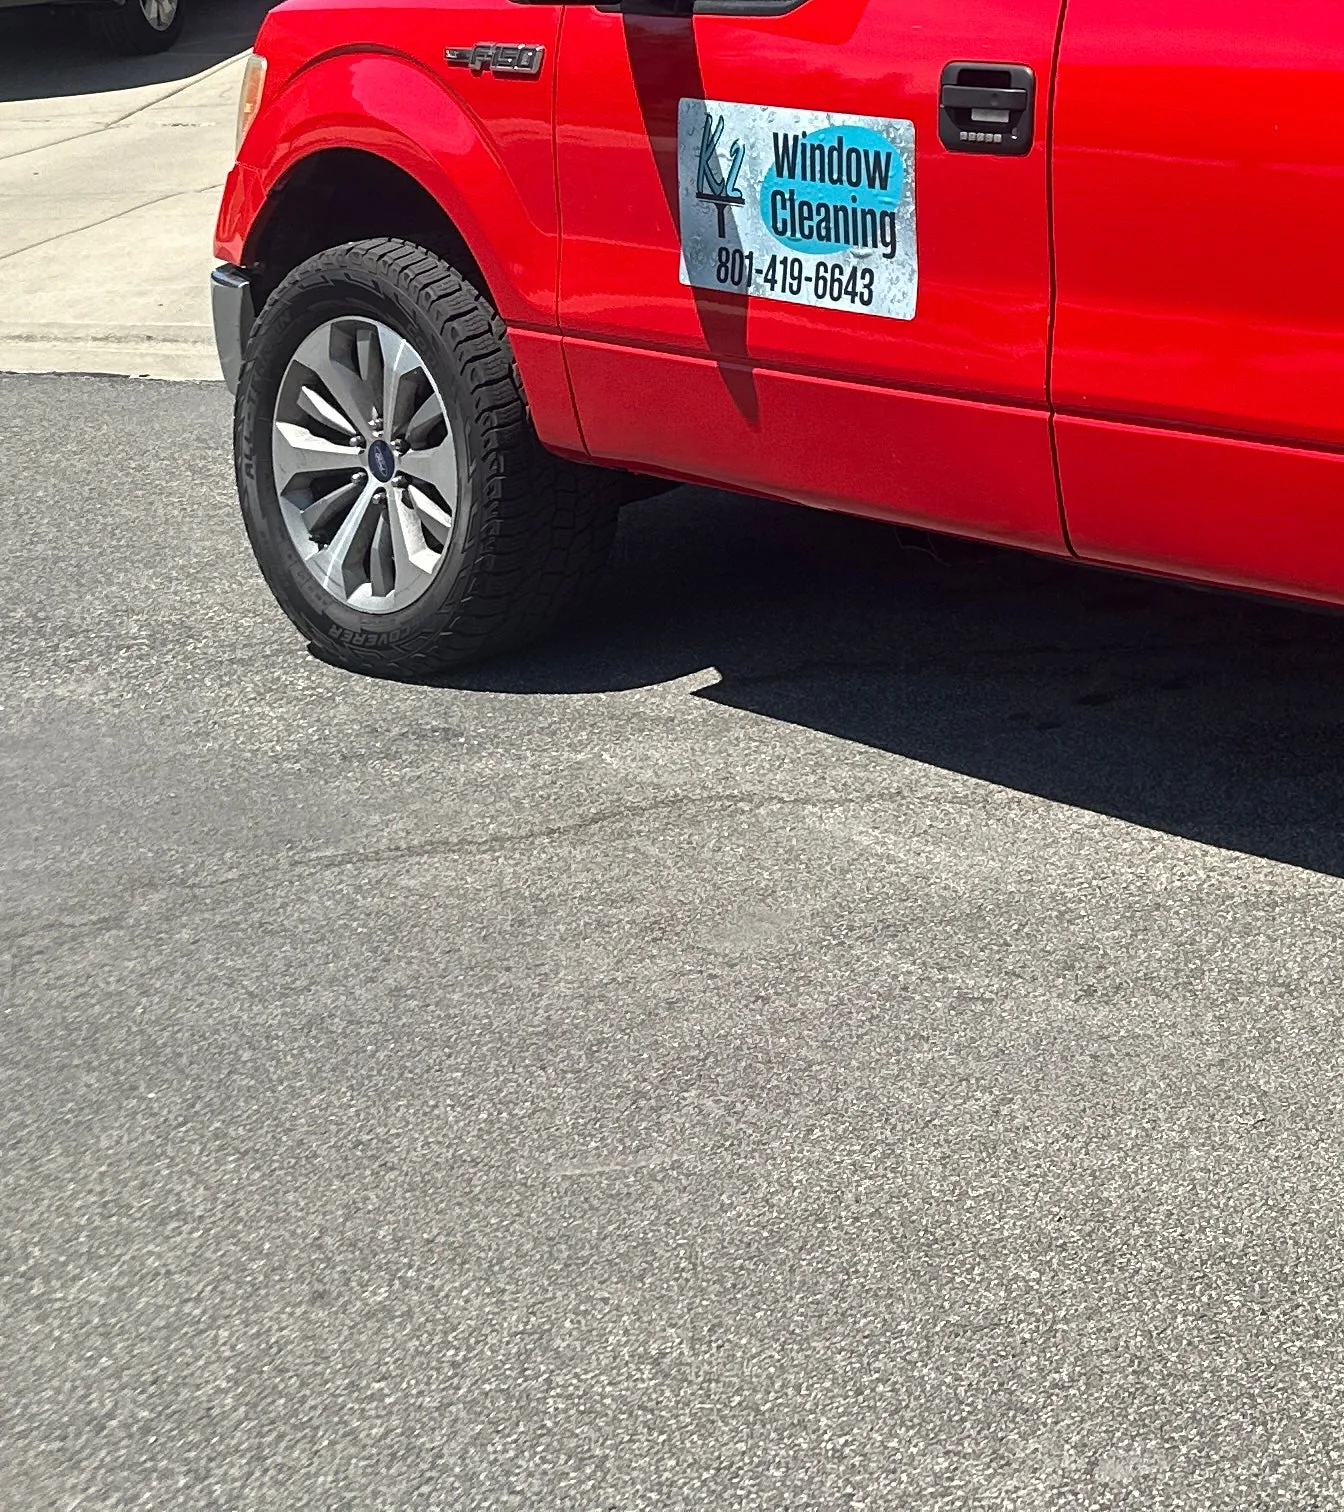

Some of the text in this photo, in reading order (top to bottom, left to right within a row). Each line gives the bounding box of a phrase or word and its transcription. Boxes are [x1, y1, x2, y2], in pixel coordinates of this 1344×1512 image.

[772, 131, 893, 191] Window
[770, 189, 897, 259] Cleaning
[715, 246, 876, 306] 801-419-6643
